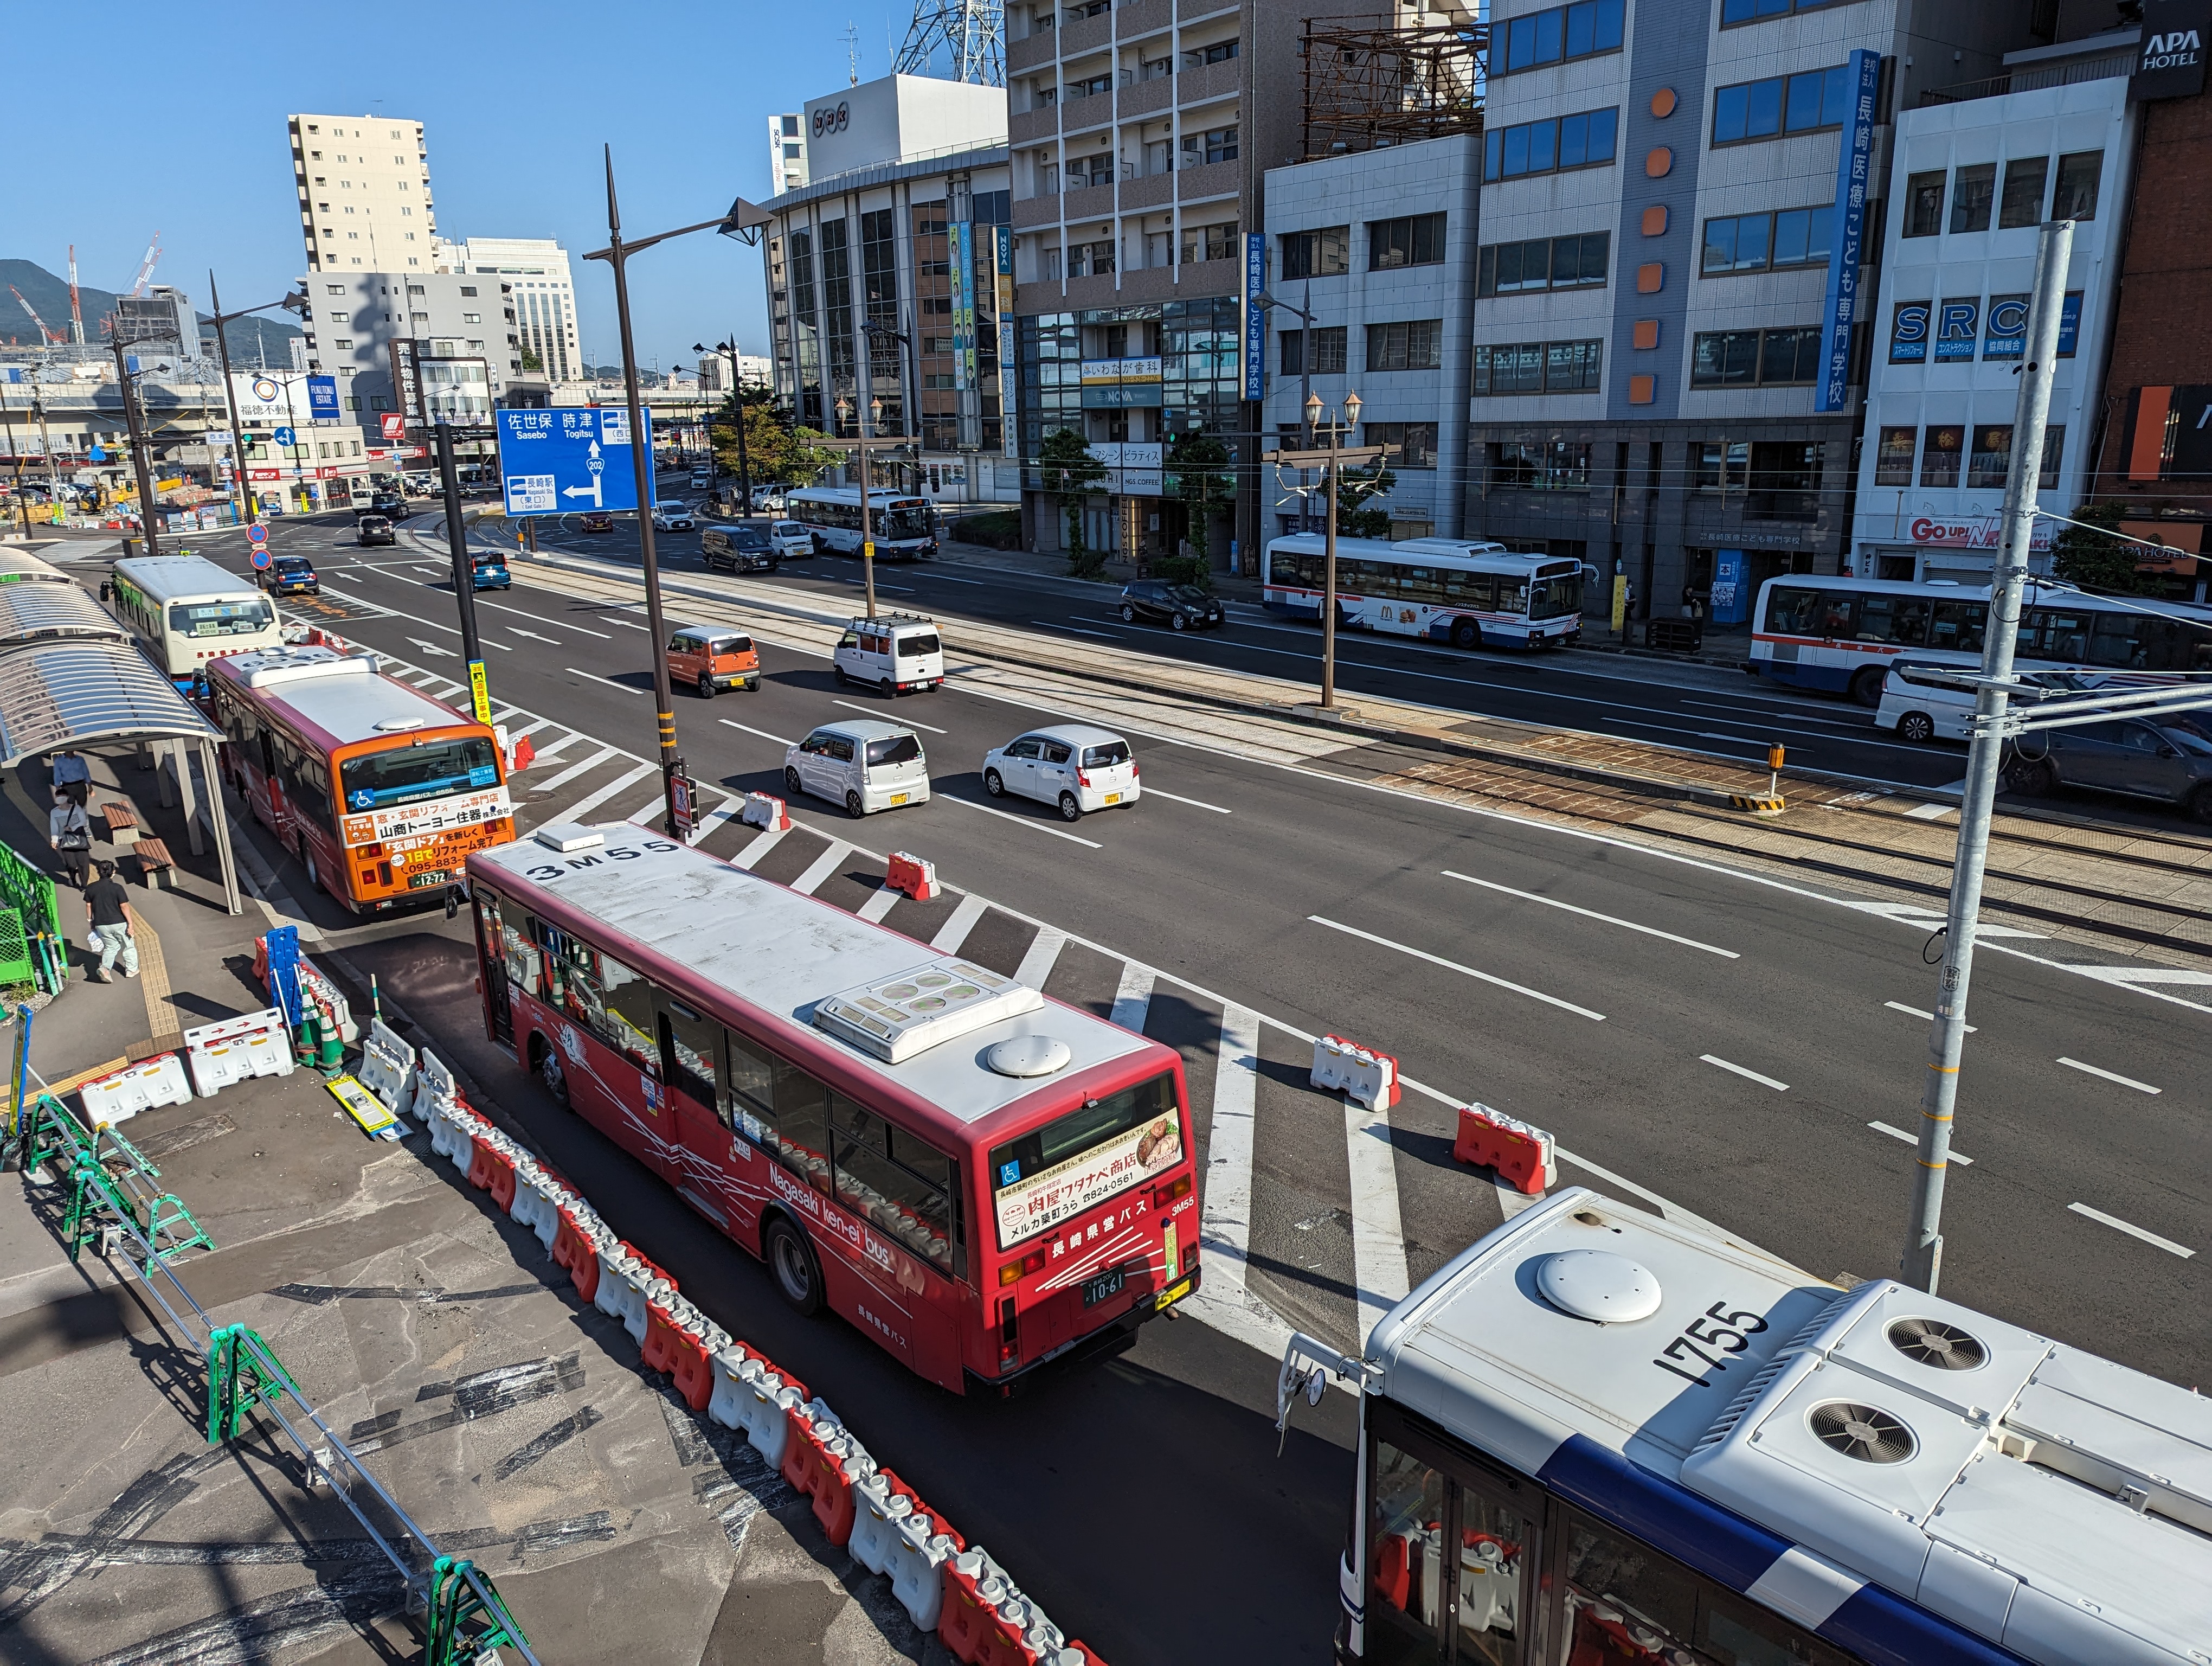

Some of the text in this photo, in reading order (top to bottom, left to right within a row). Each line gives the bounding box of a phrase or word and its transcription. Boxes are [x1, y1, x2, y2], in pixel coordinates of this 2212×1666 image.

[2145, 30, 2201, 55] APA
[2143, 52, 2198, 70] HOTEL
[1828, 94, 1873, 405] 長崎医療こども専門学校
[1895, 300, 2029, 341] SRC
[1894, 345, 1924, 355] スマートリフォーム
[1938, 343, 1974, 354] コンストラクション
[1989, 341, 2021, 352] 協同組合
[1092, 361, 1158, 375] いわなが歯科
[397, 343, 419, 416] 売買物件募集
[311, 385, 334, 394] FUKUTOKU
[1108, 390, 1133, 403] NOVA
[316, 395, 332, 404] ESTATE
[240, 405, 298, 415] 福徳不動産
[507, 413, 593, 430] 佐世保 時津
[516, 430, 594, 440] Sasebo Togitsu
[1095, 449, 1159, 462] マシーン ピラティス
[589, 461, 602, 470] 202
[528, 478, 553, 488] 長崎駅
[1708, 534, 1800, 544] 長崎医療こども専門学校
[397, 791, 432, 803] 長崎県営バス
[347, 823, 372, 831] マド本舗
[380, 807, 510, 839] 山商トーヨー住器 株式会社
[409, 855, 466, 873] 095-883-3
[526, 841, 679, 881] 3M55
[421, 873, 446, 885] 12-72
[740, 1142, 749, 1154] 入口
[1027, 1178, 1062, 1199] 長崎和牛指定店
[1028, 1152, 1136, 1216] 肉屋ワタナベ商店
[769, 1163, 889, 1265] Nagasaki ken-ei bus
[1172, 1196, 1194, 1216] 3M55
[1011, 1199, 1078, 1240] メルカ築町うら
[1052, 1200, 1147, 1258] 長崎県営バス
[1092, 1273, 1122, 1303] 10-61
[857, 1304, 907, 1349] 長崎県営バス
[1652, 1300, 1769, 1388] 1755
